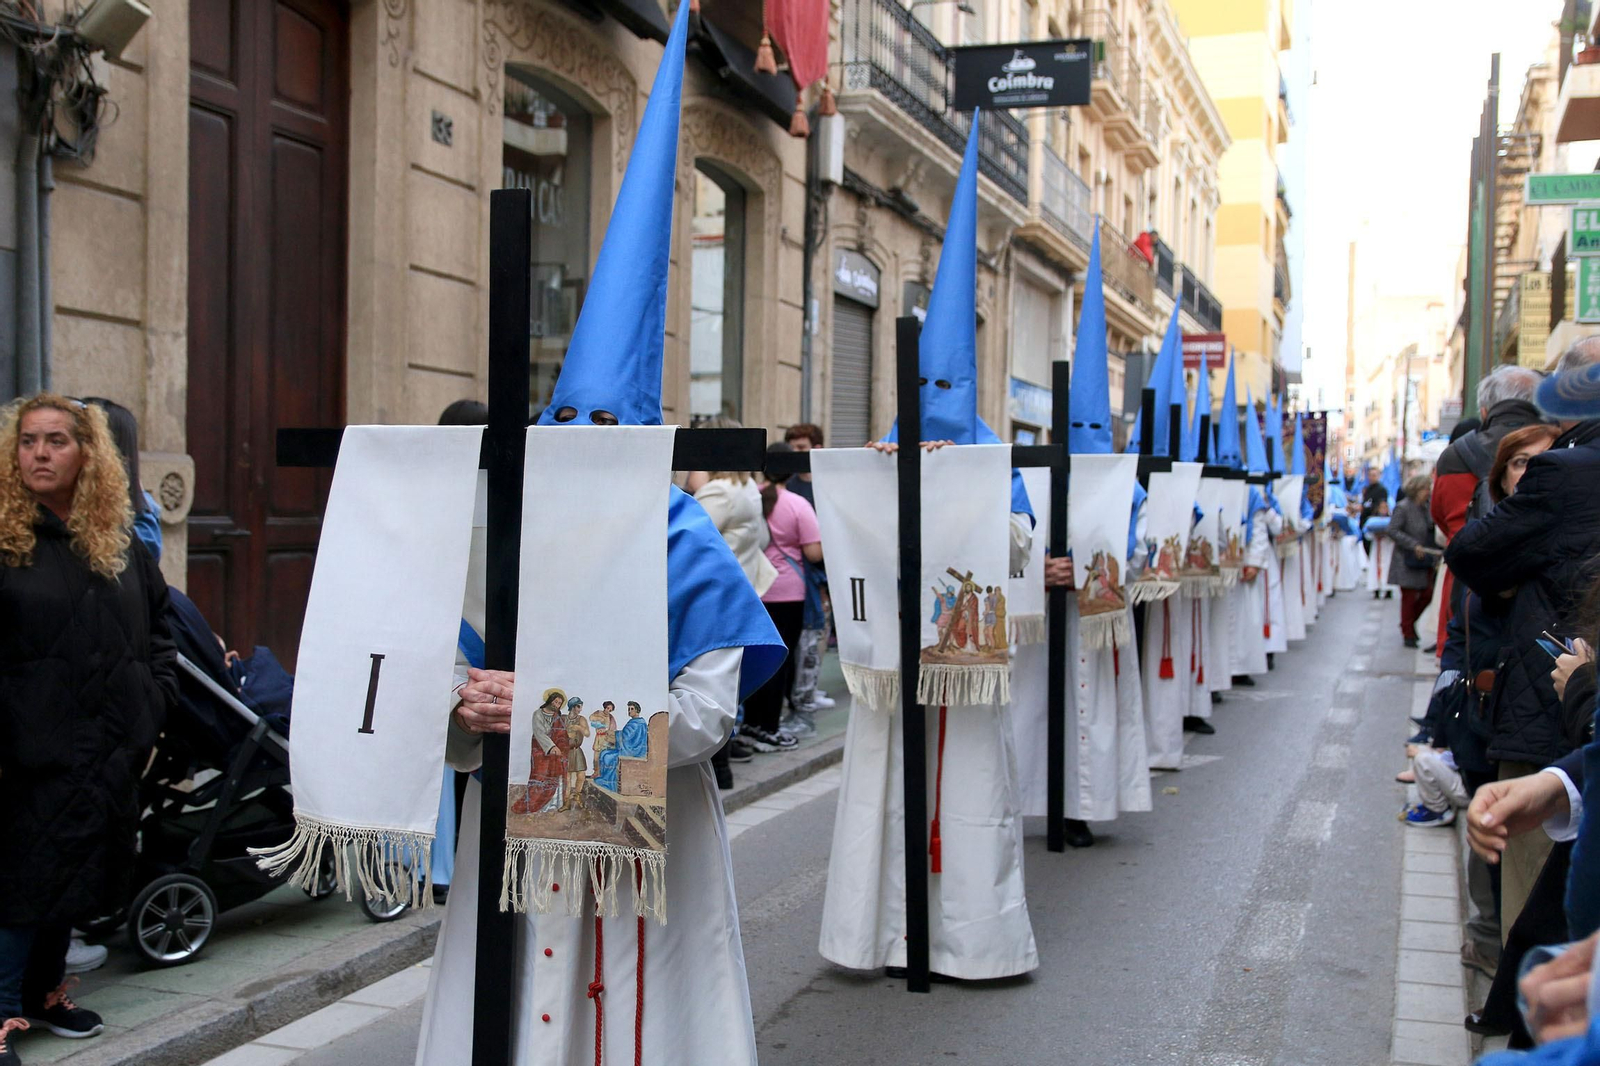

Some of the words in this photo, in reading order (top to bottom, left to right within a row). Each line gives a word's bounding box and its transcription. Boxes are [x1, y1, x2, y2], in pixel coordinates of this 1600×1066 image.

[988, 71, 1054, 93] Coimbra
[849, 577, 867, 622] II
[357, 653, 386, 735] I
